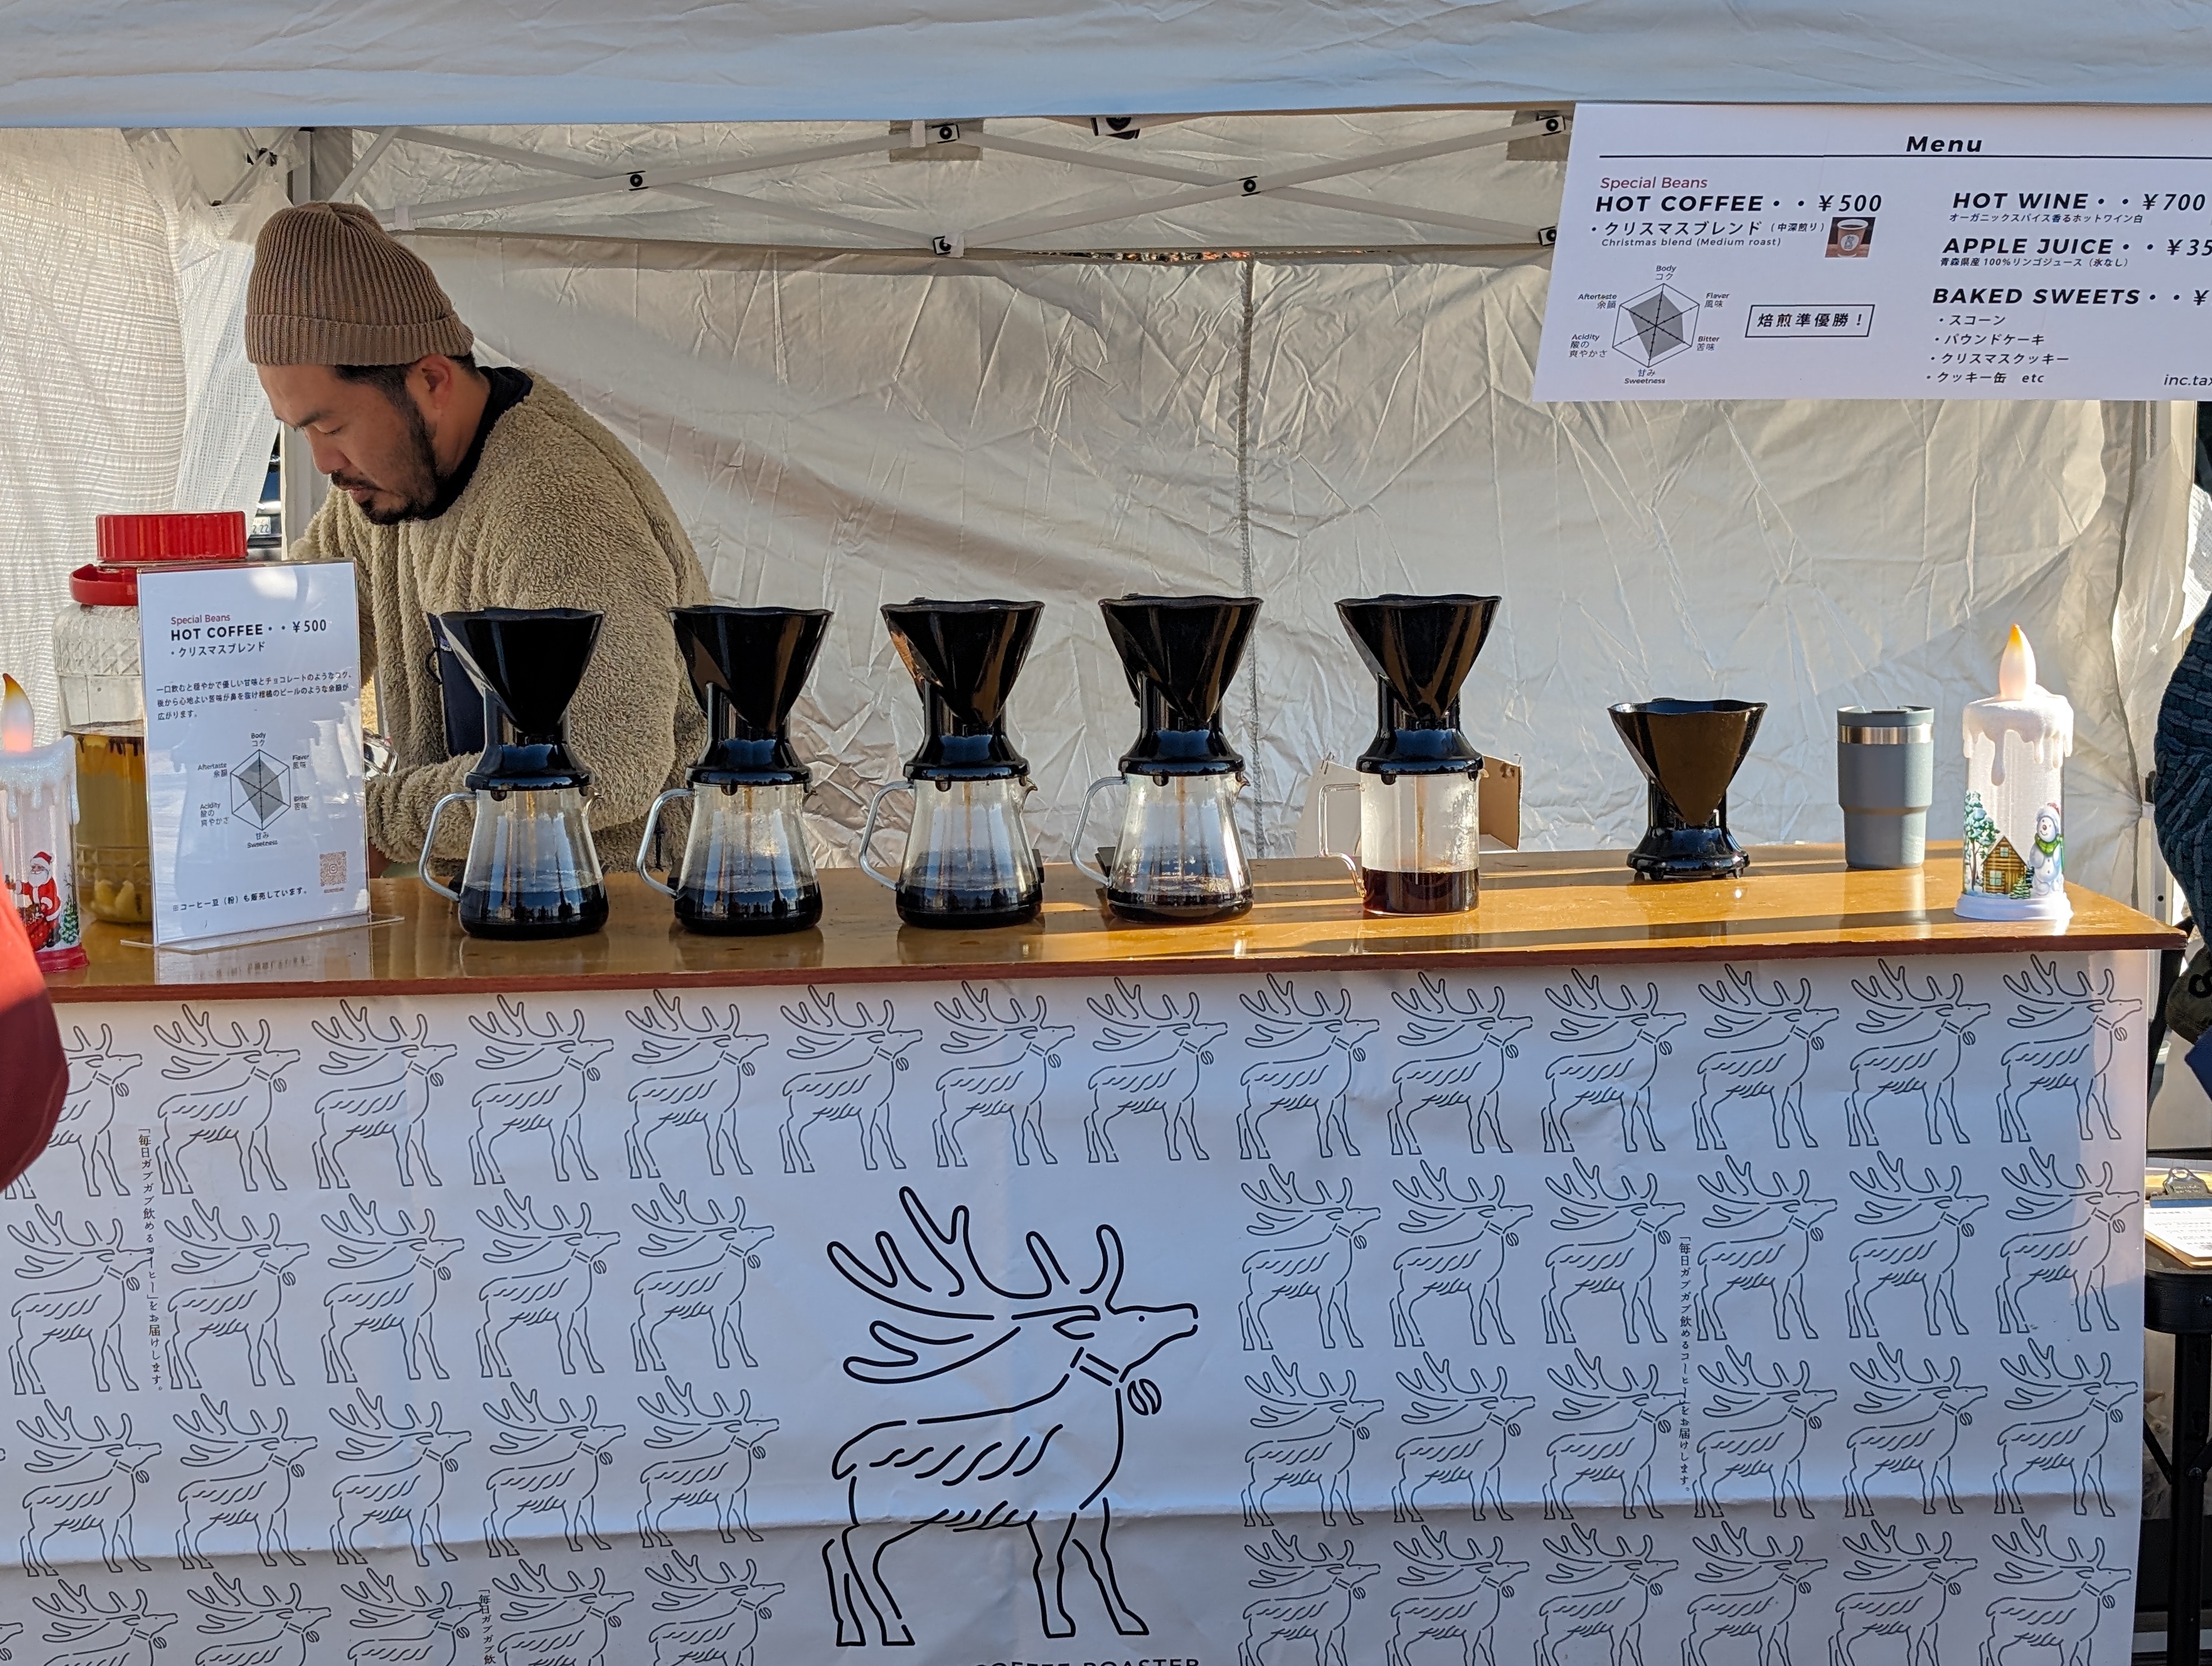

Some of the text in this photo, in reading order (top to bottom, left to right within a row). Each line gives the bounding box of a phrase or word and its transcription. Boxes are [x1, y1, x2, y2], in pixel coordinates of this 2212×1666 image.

[1906, 136, 1982, 152] Menu
[1600, 177, 1708, 191] Special Beans
[1596, 195, 1882, 212] HOT COFFEE ¥500
[1953, 193, 2205, 210] HOT WINE ¥700
[1602, 238, 1781, 247] Christmas blend (Medium roast)
[1943, 238, 2027, 254] APPLE
[2037, 238, 2113, 254] JUICE
[1932, 288, 2022, 304] BAKED
[2033, 289, 2141, 304] SWEETS
[1705, 300, 1724, 308] 風味
[1571, 334, 1600, 342] Acidity
[2022, 373, 2044, 383] etc
[171, 614, 230, 626] Special Beans
[171, 619, 326, 641] HOT COFFEE ¥500
